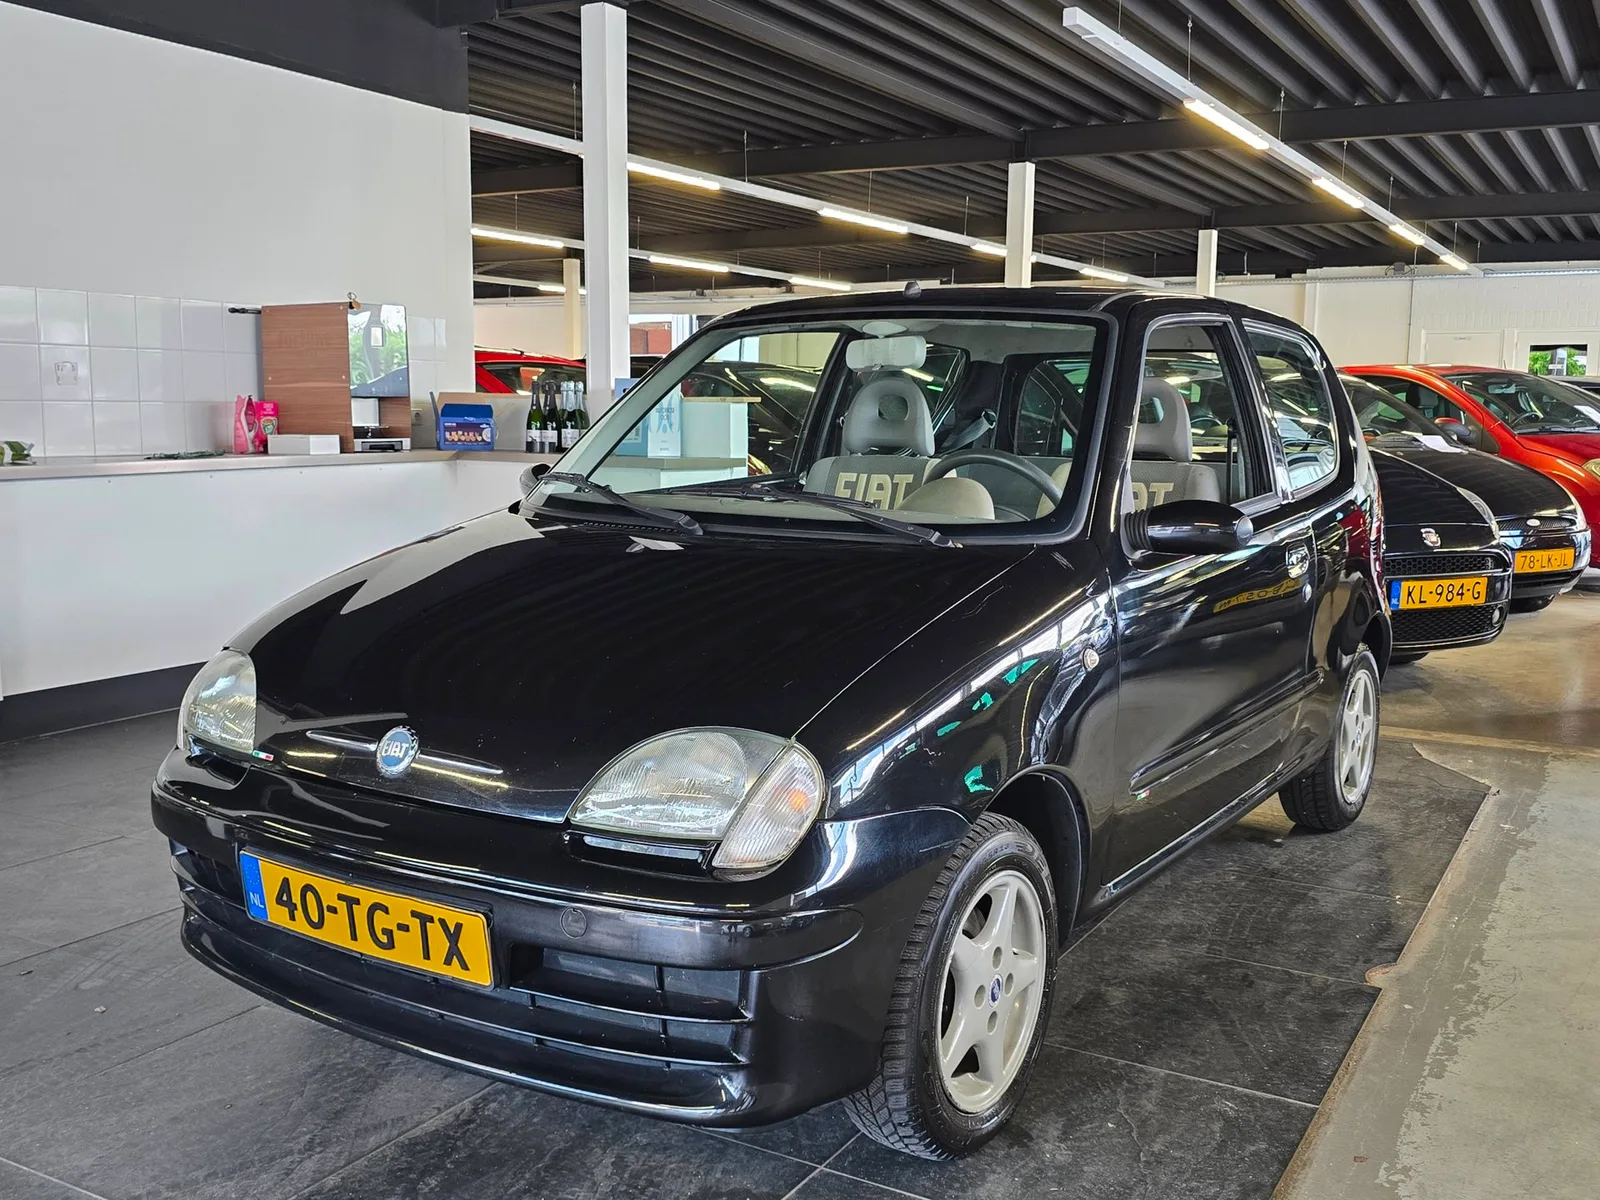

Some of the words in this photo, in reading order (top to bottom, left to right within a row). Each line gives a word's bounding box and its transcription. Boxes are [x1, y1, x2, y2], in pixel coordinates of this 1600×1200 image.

[834, 472, 914, 510] FIAT
[1131, 482, 1175, 513] AT
[1520, 553, 1568, 570] 78-LK-JL
[1406, 581, 1481, 605] KL-984-G
[381, 740, 409, 758] FIAT
[249, 891, 265, 909] NL
[275, 877, 471, 971] 40-TG-TX
